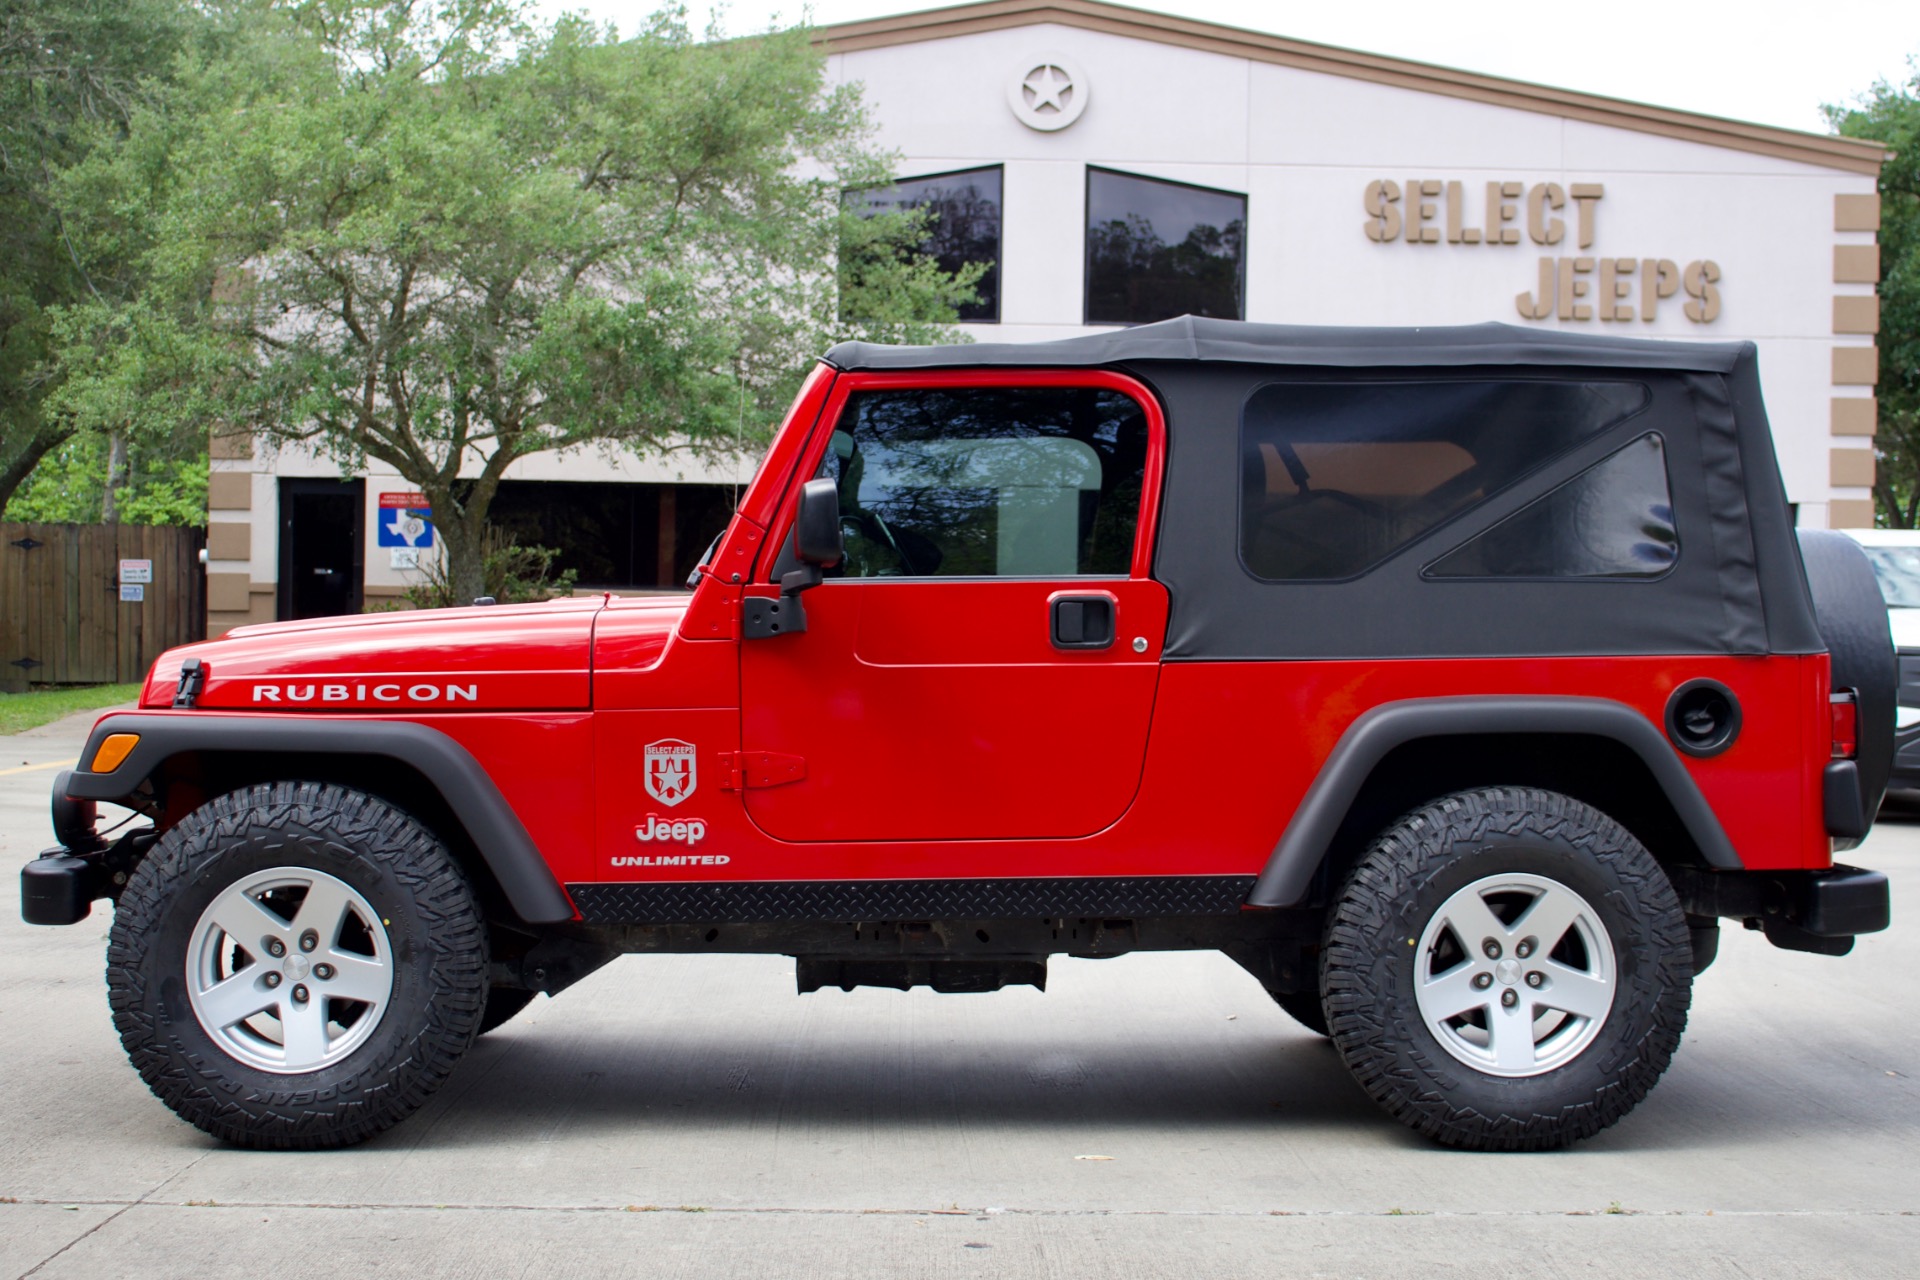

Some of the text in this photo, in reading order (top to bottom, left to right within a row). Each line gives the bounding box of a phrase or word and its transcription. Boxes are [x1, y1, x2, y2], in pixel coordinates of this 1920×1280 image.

[1364, 180, 1604, 249] SELECT
[1515, 257, 1721, 323] JEEPS
[253, 684, 477, 702] RUBICON
[646, 746, 694, 755] SELECT JEEPS
[636, 817, 705, 845] Jeep
[611, 855, 731, 867] UNLIMITED
